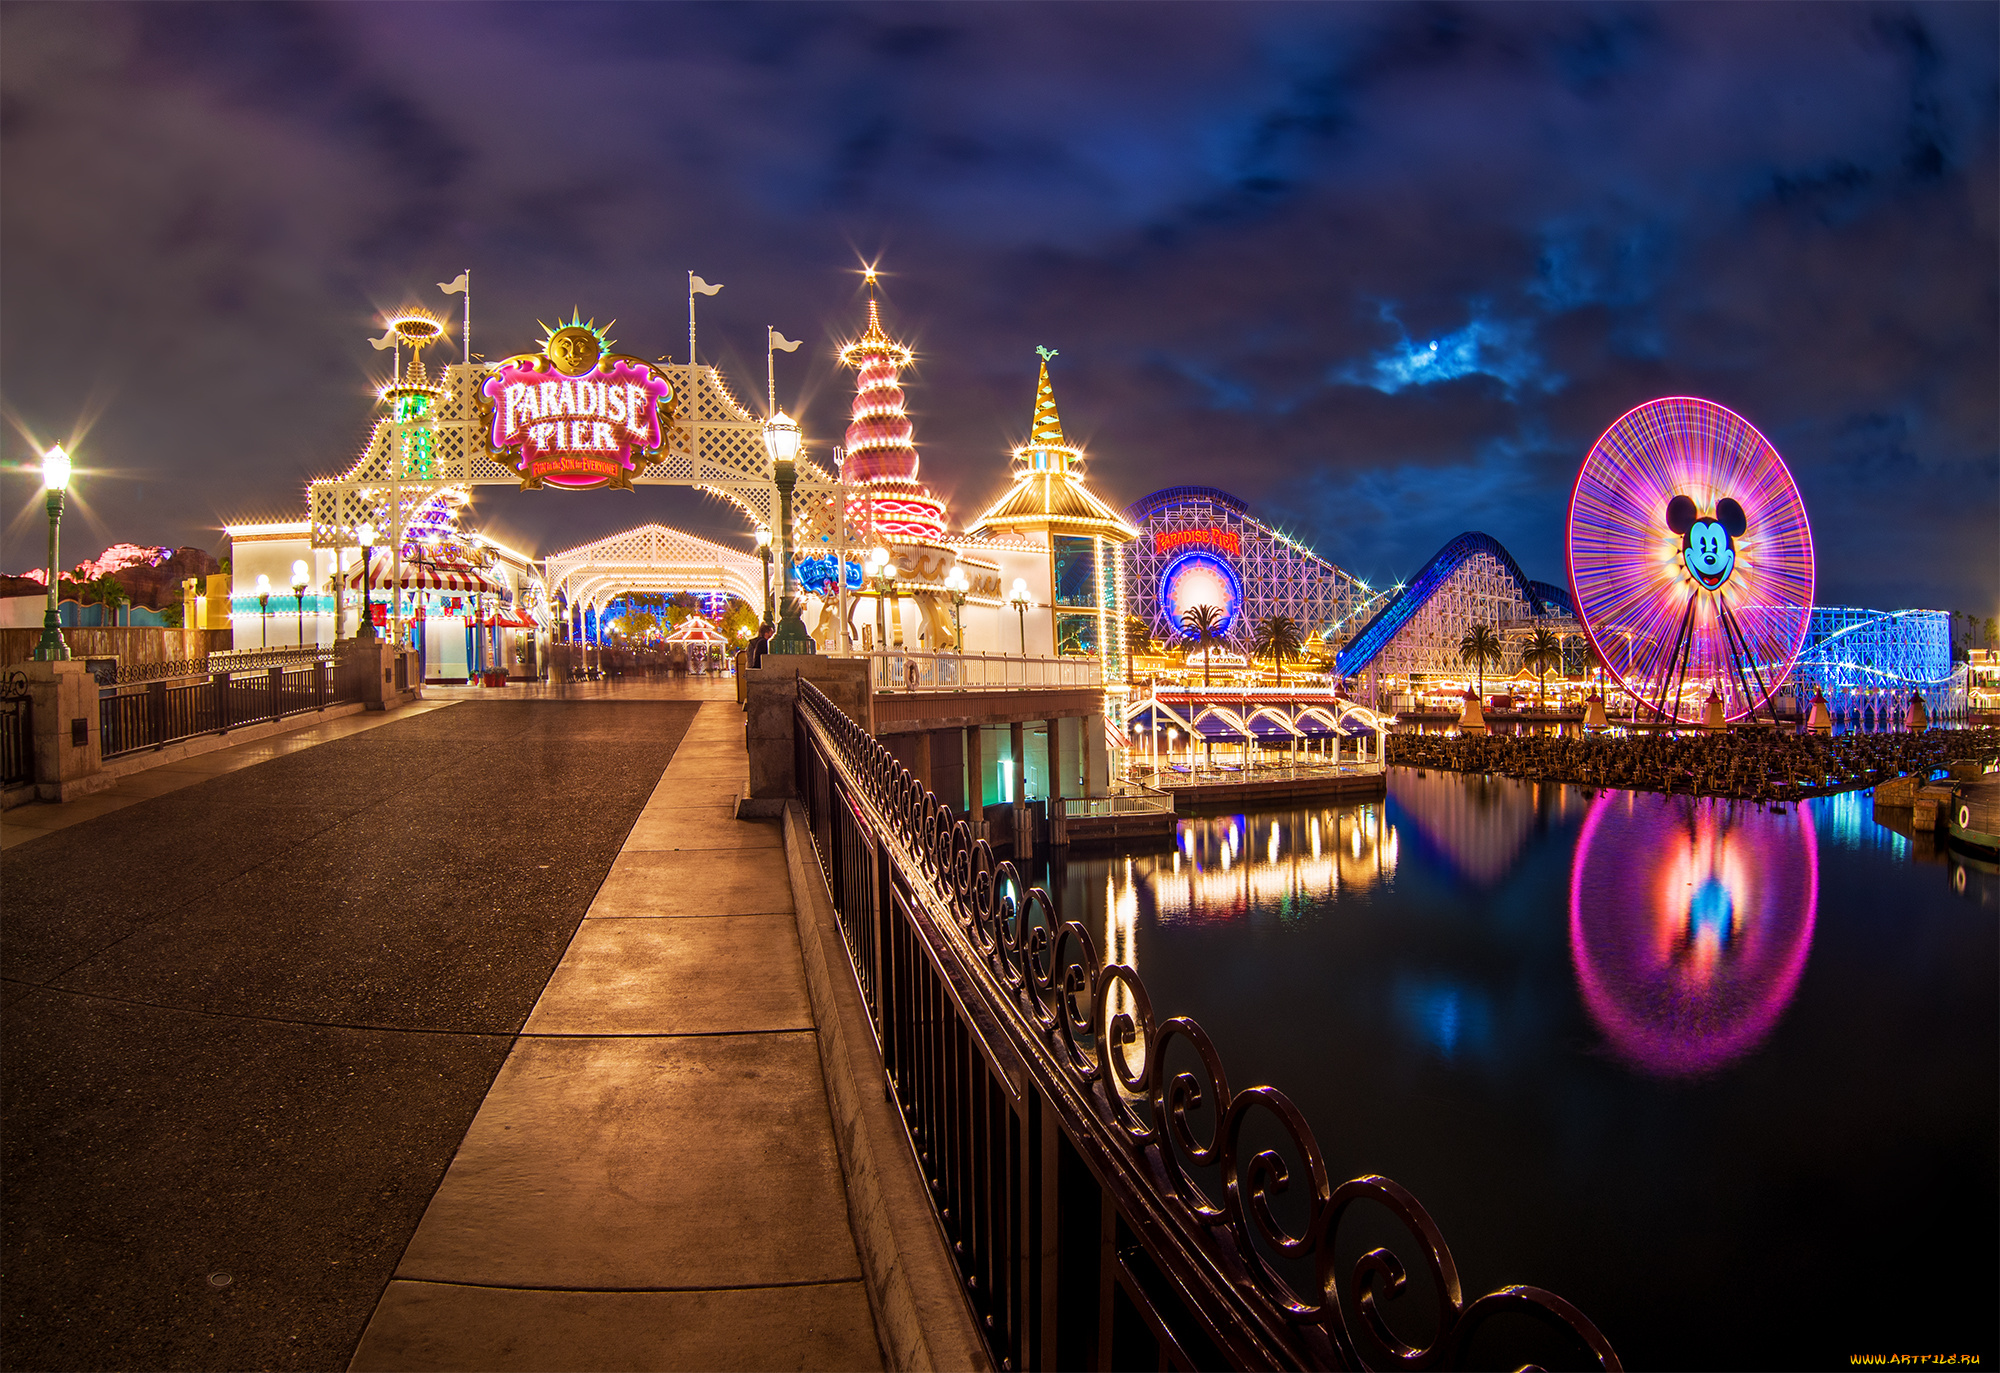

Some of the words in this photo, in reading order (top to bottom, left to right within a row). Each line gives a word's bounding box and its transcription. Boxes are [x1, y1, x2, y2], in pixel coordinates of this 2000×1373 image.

[504, 380, 649, 439] PARADISE
[529, 420, 619, 452] PIER
[532, 461, 547, 477] FUN
[560, 456, 575, 472] SUN
[582, 457, 619, 477] EVERYONE!
[1155, 529, 1210, 555] PARADISE
[1211, 528, 1241, 557] PIER
